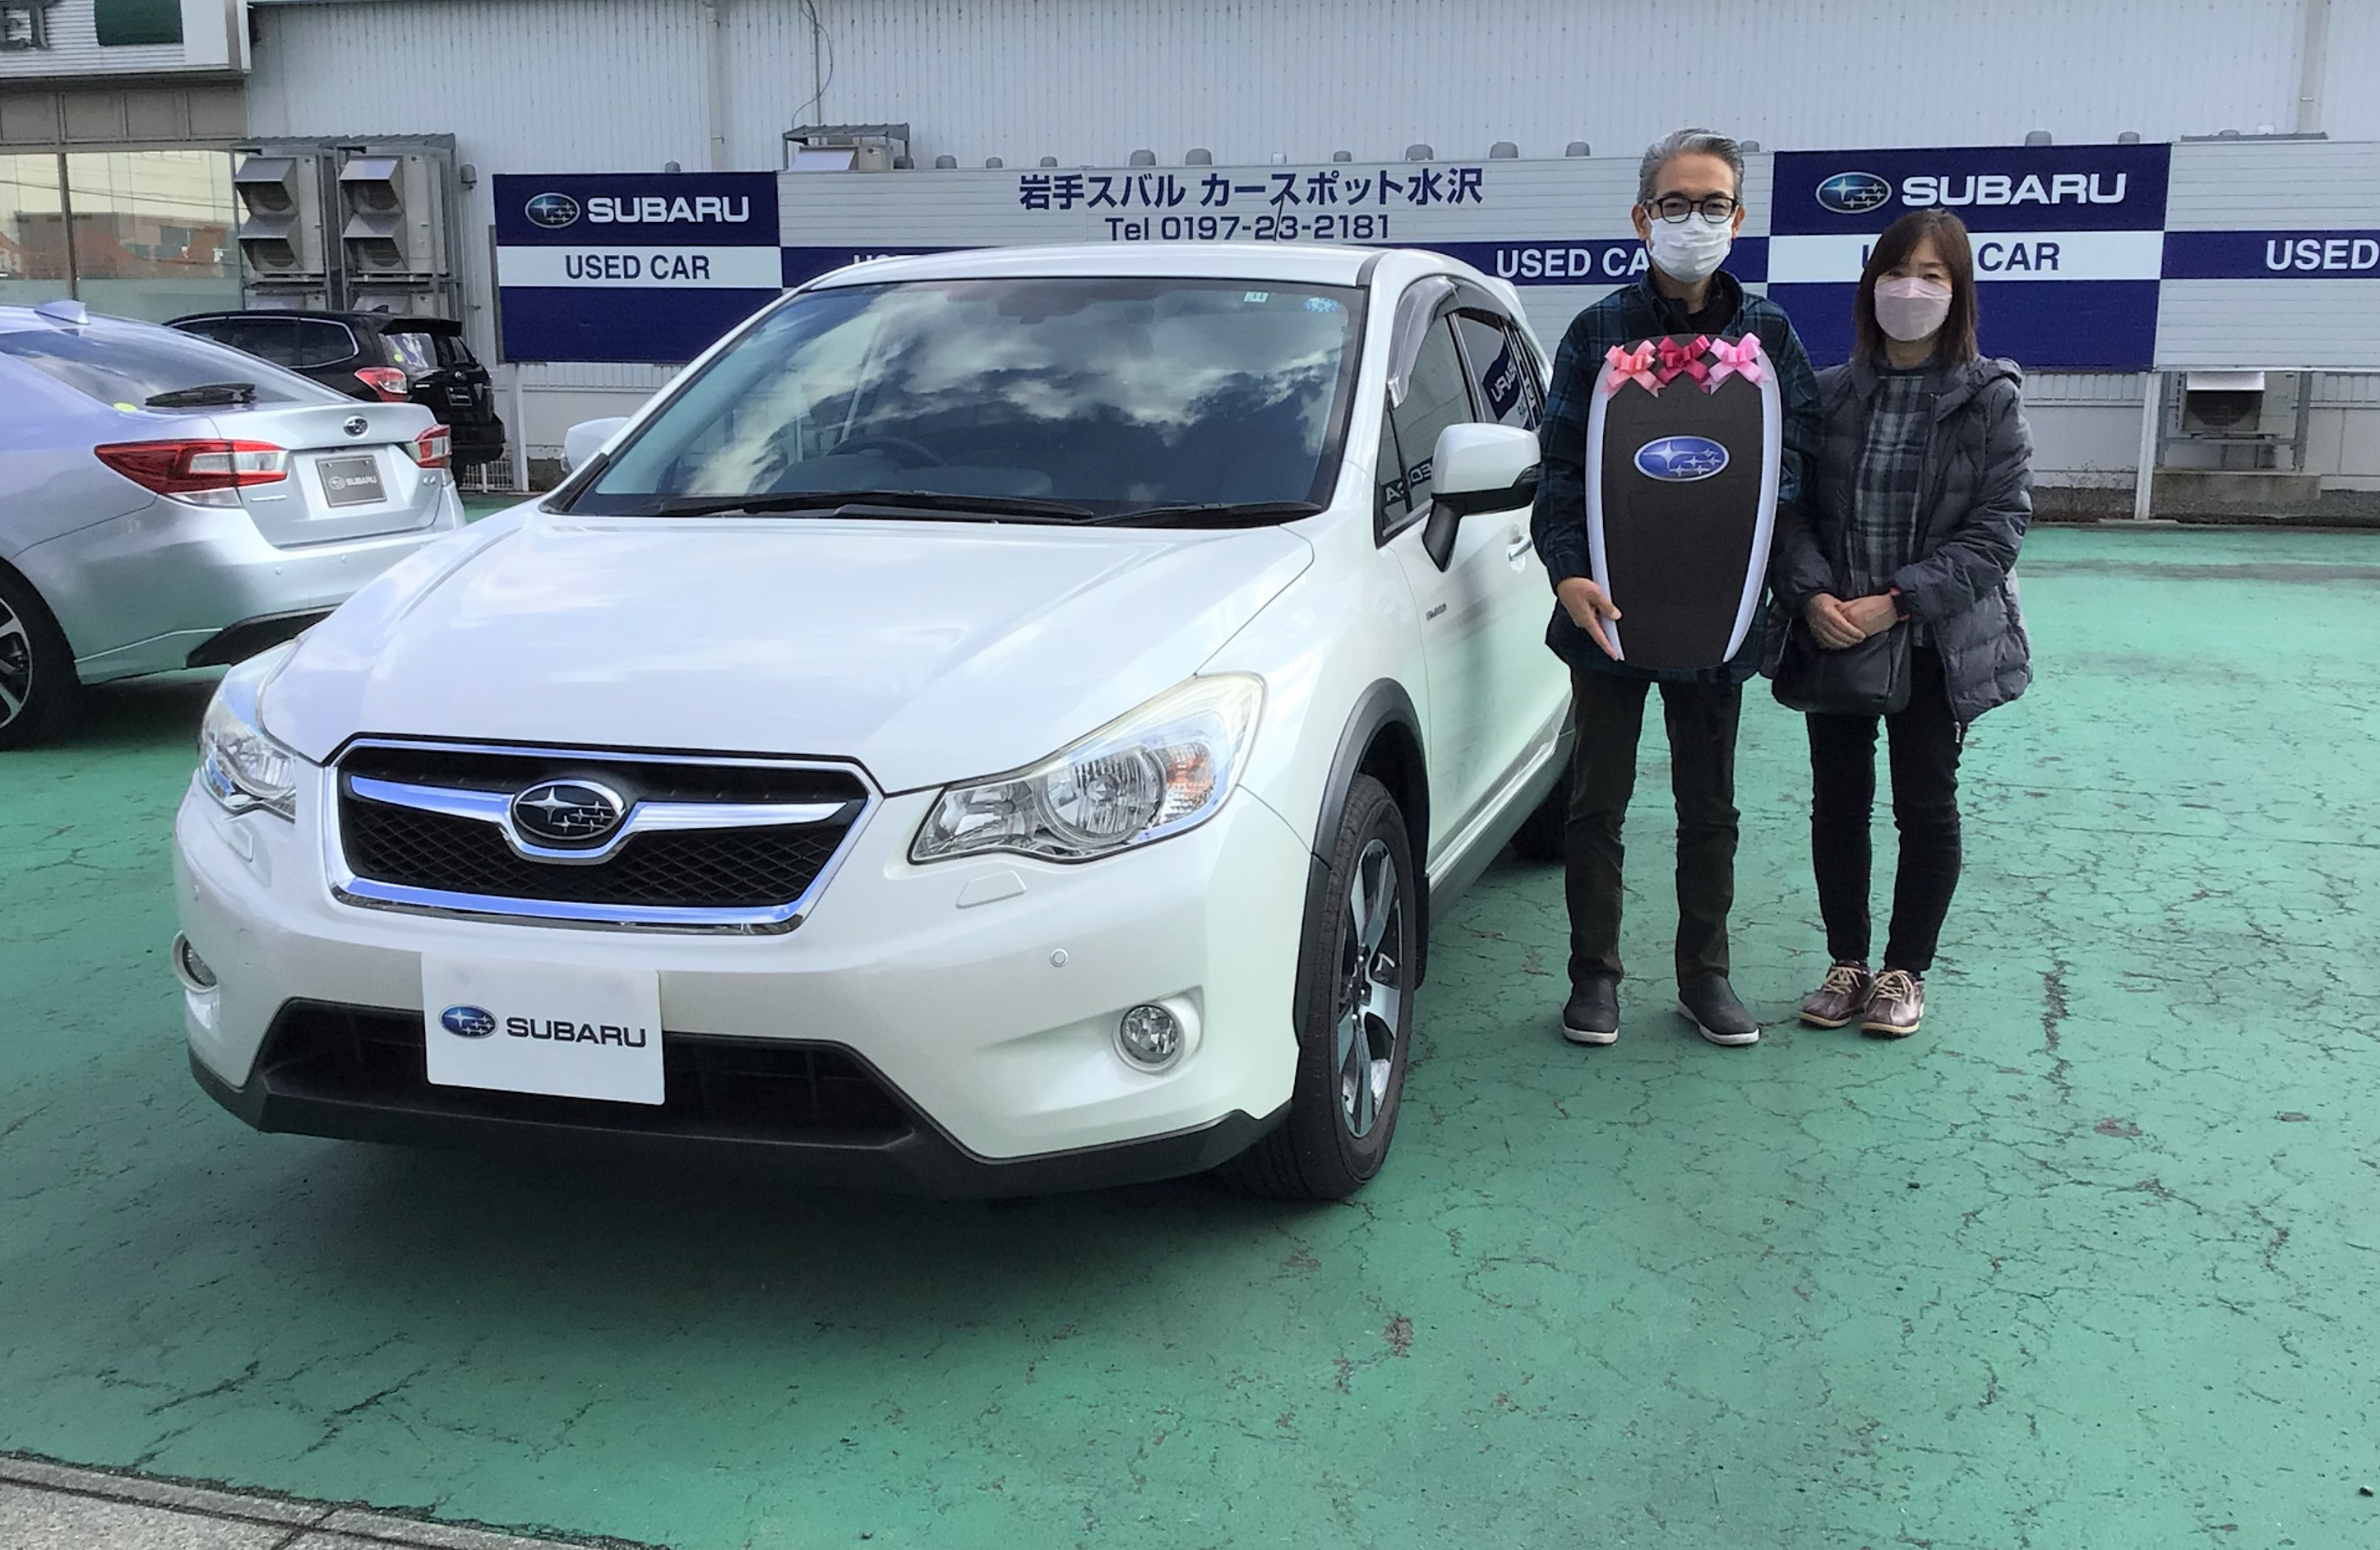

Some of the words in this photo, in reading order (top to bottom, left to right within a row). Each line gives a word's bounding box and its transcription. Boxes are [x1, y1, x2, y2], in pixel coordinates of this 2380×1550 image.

[1019, 174, 1185, 211] 岩手スバル
[1200, 167, 1483, 207] カースポット水沢
[1902, 173, 2127, 207] SUBARU
[587, 196, 749, 223] SUBARU
[1105, 217, 1149, 240] Tel
[1161, 214, 1389, 241] 0197-23-2181
[566, 254, 641, 280] USED
[649, 254, 710, 280] CAR
[1496, 248, 1592, 278] USED
[1602, 247, 1651, 277] CA
[1977, 242, 2060, 271] CAR
[2266, 238, 2380, 271] USED
[506, 1016, 647, 1048] SUBARU
